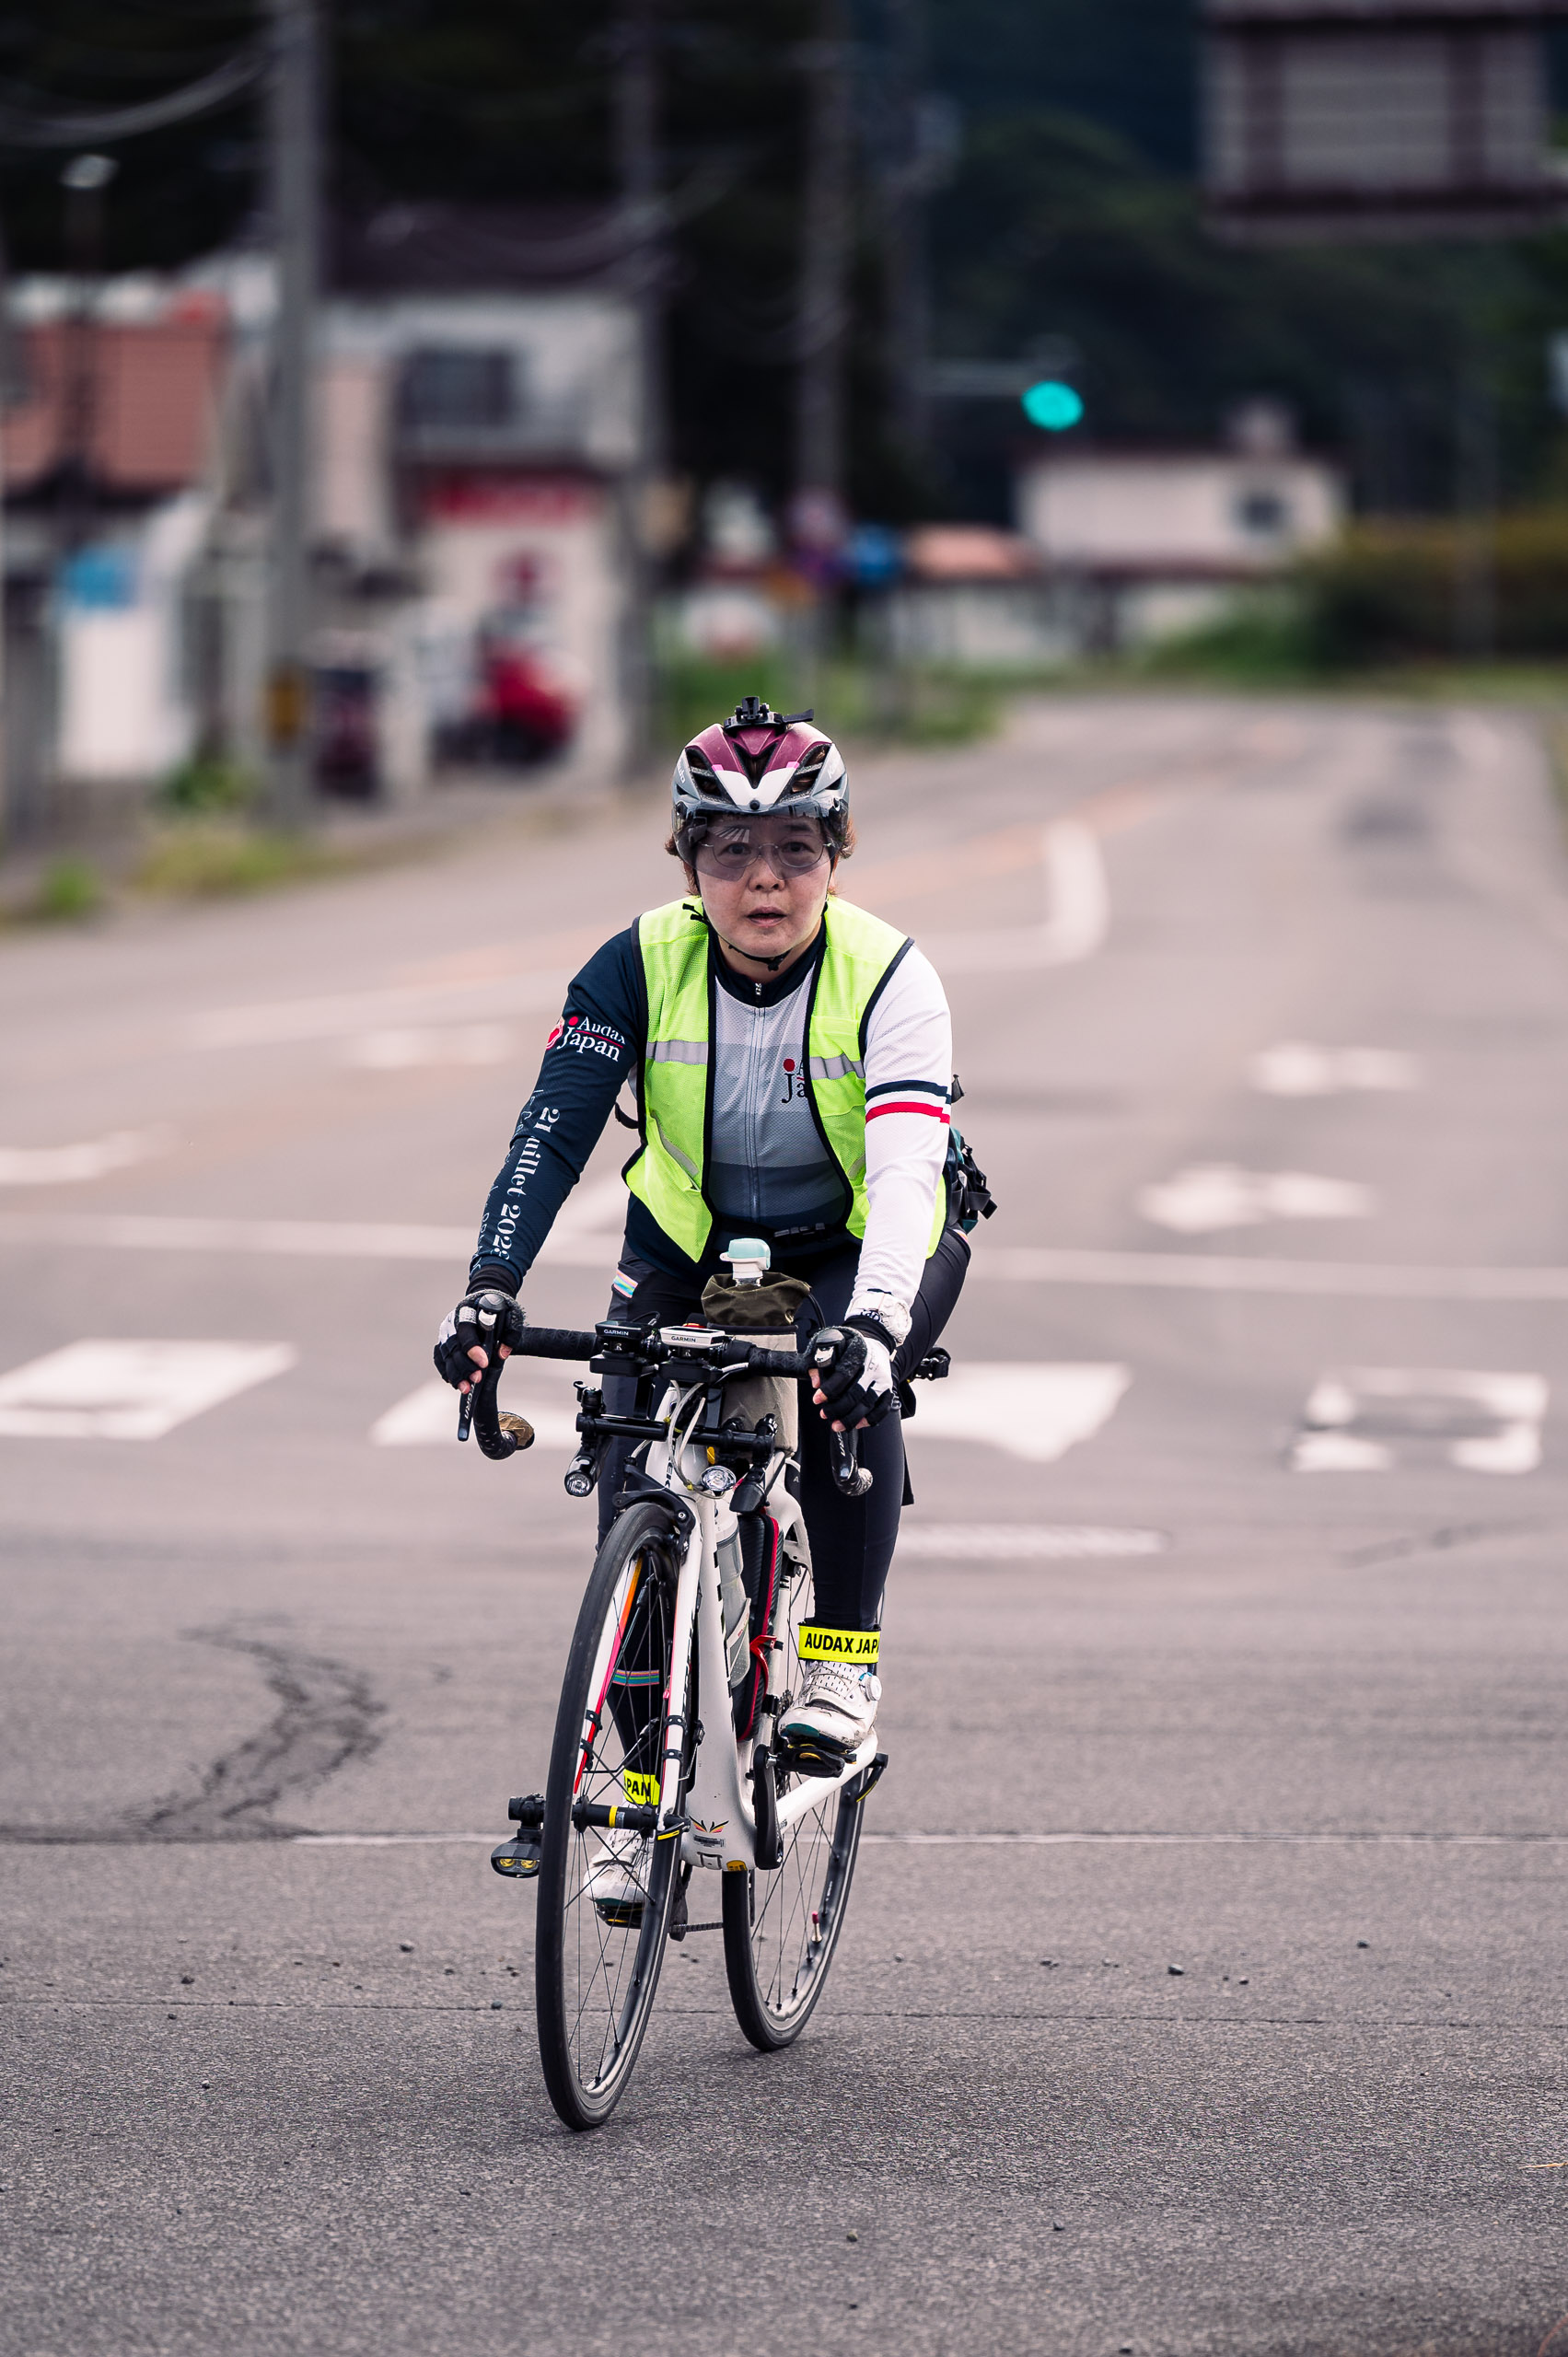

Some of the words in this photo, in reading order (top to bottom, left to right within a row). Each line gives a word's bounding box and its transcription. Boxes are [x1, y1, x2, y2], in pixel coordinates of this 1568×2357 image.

[576, 1016, 626, 1045] Audax
[556, 1026, 621, 1062] Japan
[534, 1107, 561, 1132] 21
[506, 1135, 541, 1197] uillet
[670, 1335, 696, 1343] GARMIN
[805, 1632, 854, 1654] AUDAX
[855, 1638, 879, 1655] JAP
[624, 1776, 651, 1797] PAN
